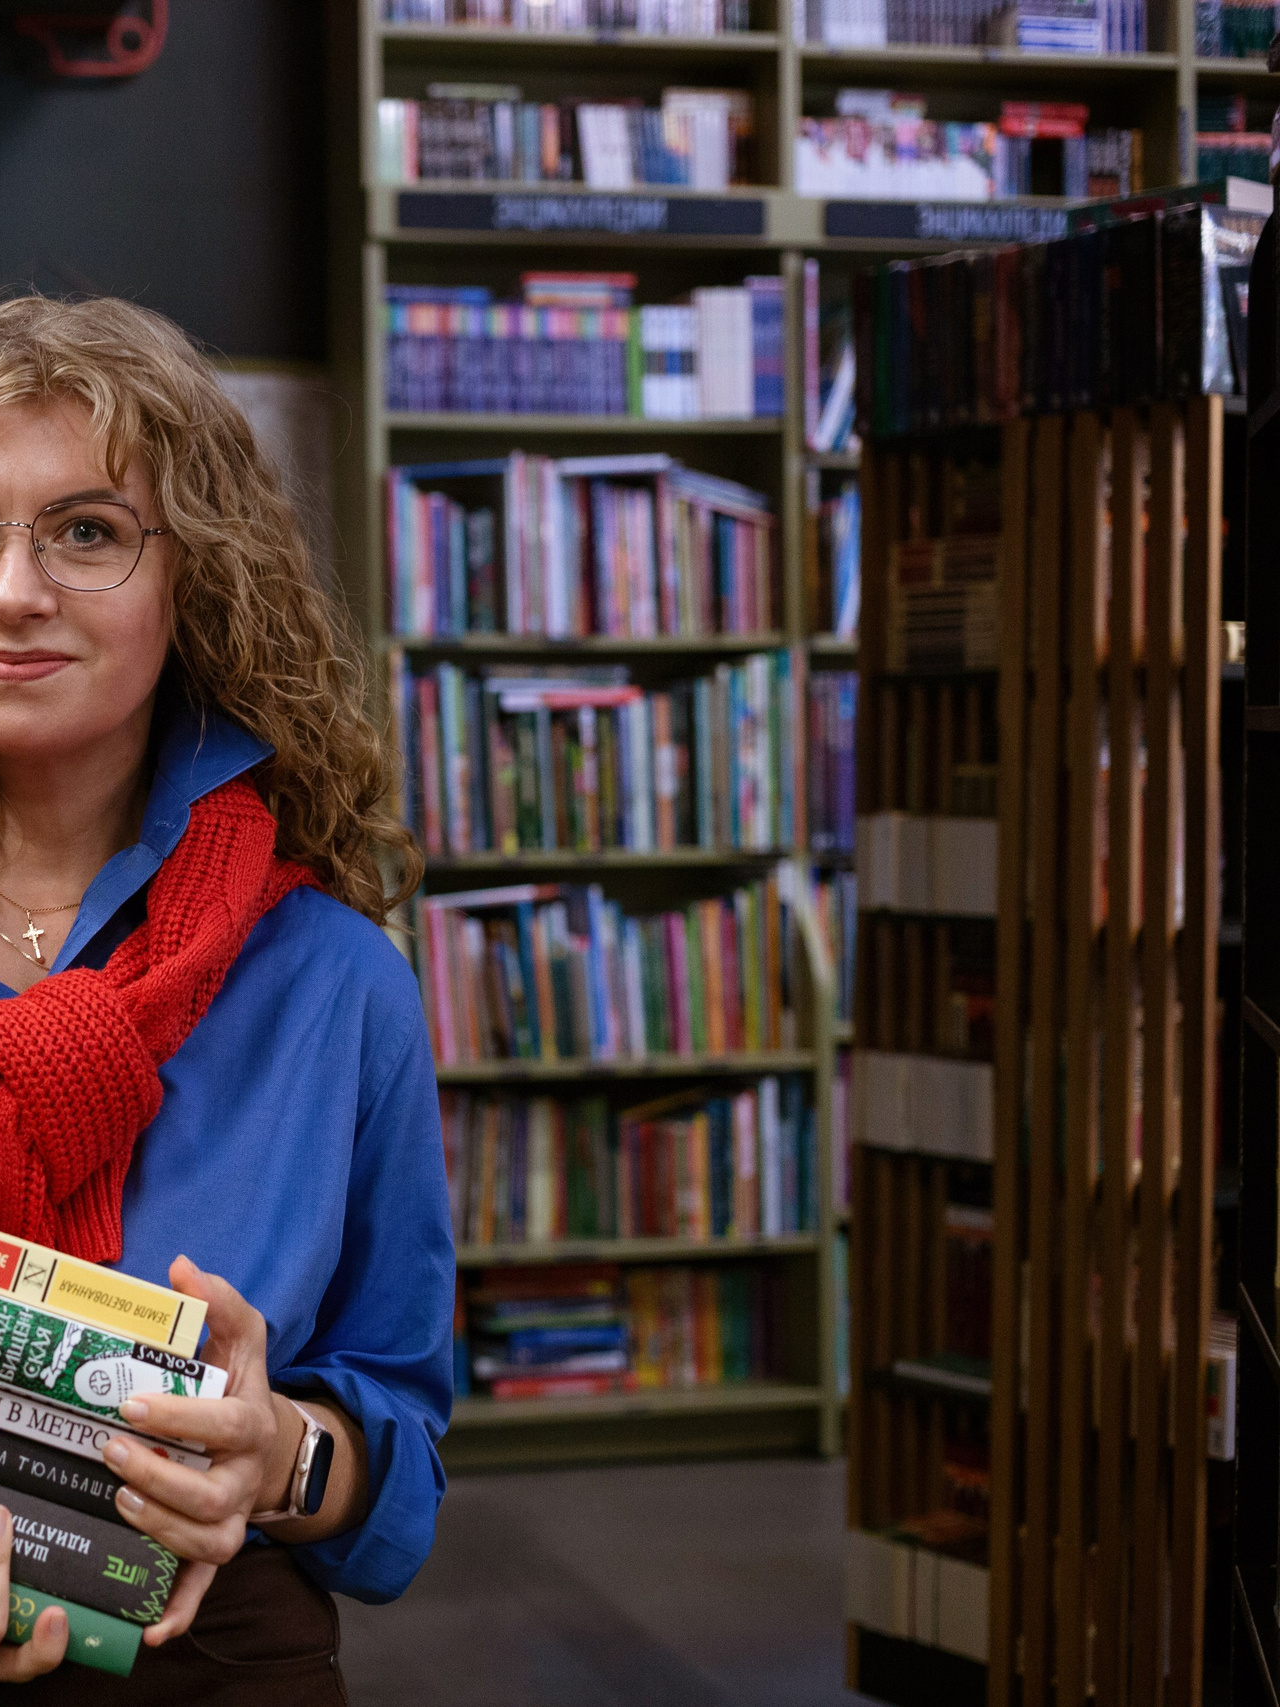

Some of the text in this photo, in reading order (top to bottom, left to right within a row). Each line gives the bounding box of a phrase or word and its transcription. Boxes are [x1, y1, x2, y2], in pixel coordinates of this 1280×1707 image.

[59, 1279, 170, 1325] ЗЕМЛЯ ОБЕТОВАННАЯ
[22, 1326, 52, 1379] СКАЯ
[6, 1401, 22, 1423] В
[26, 1407, 110, 1450] МЕТРО
[18, 1455, 114, 1500] ТЮЛЬБАШЕ
[11, 1538, 49, 1562] ШАМ
[12, 1515, 91, 1555] ИДИАТУЛ
